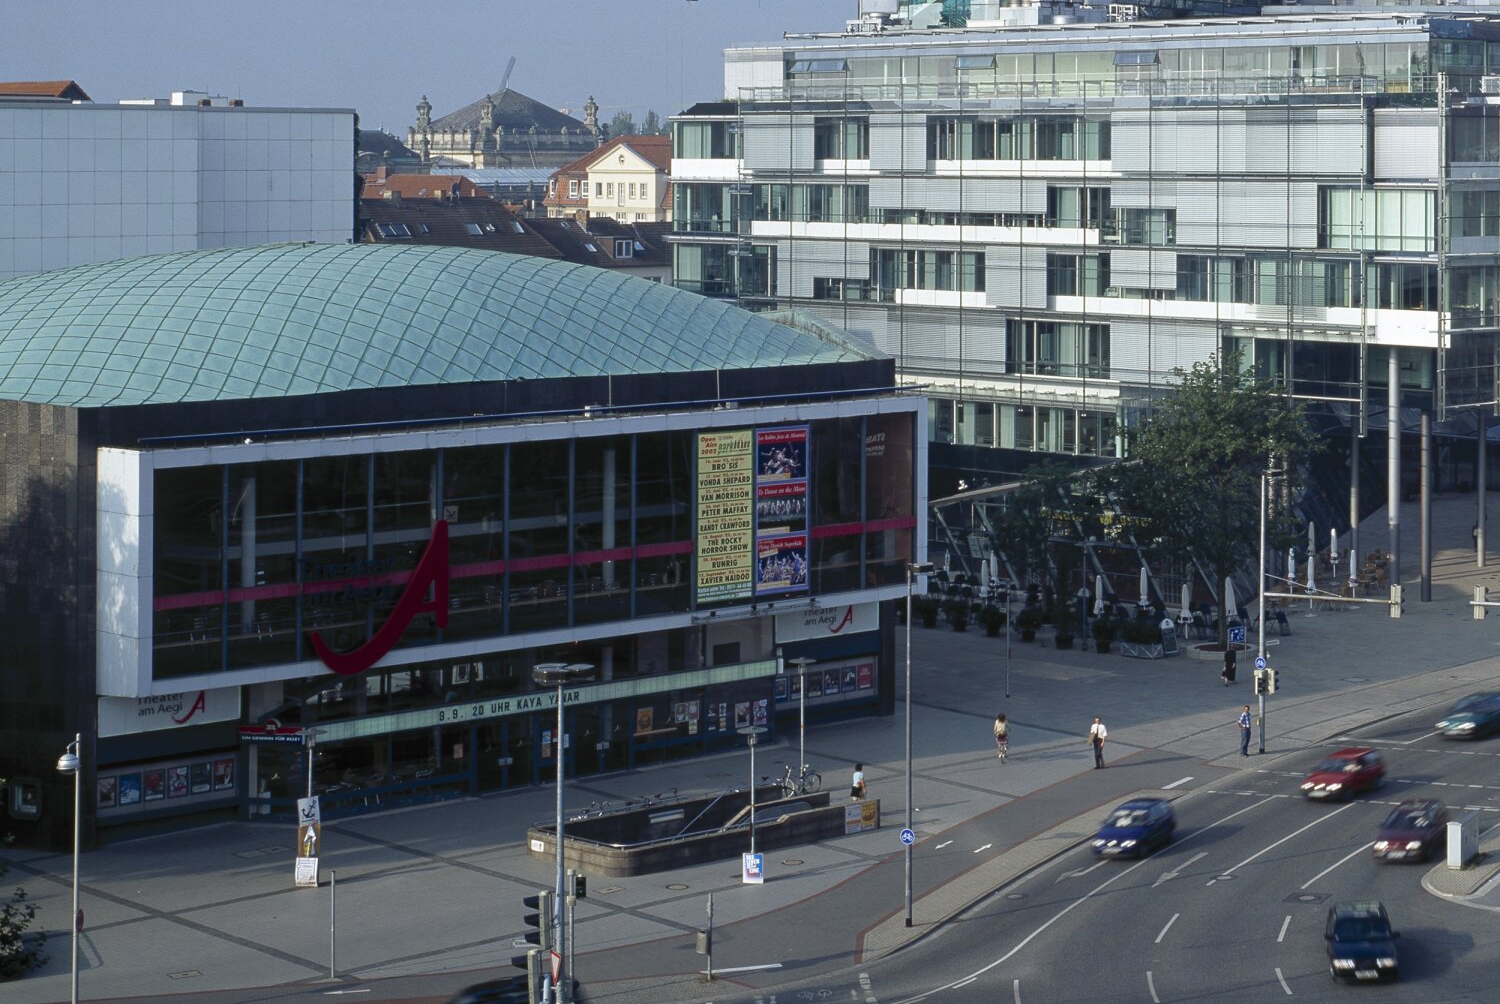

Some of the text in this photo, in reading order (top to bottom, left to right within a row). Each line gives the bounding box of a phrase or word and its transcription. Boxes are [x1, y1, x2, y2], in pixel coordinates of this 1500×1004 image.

[700, 479, 721, 487] VONDA
[723, 476, 751, 484] SHEPARD
[701, 491, 750, 502] VAN MORRISON
[702, 506, 749, 517] PETER MAFFAY
[700, 524, 719, 532] RANDY
[720, 521, 750, 530] CRAWFORD
[708, 537, 743, 547] THE ROCKY
[702, 544, 749, 555] HORROR SHOW
[712, 560, 738, 569] RUNRIG
[701, 573, 750, 585] XAVIER NAIDOO
[819, 615, 837, 624] Aegi
[138, 702, 183, 717] am Aegi
[473, 706, 484, 716] 20
[491, 702, 510, 714] UHR
[517, 698, 542, 710] KAYA
